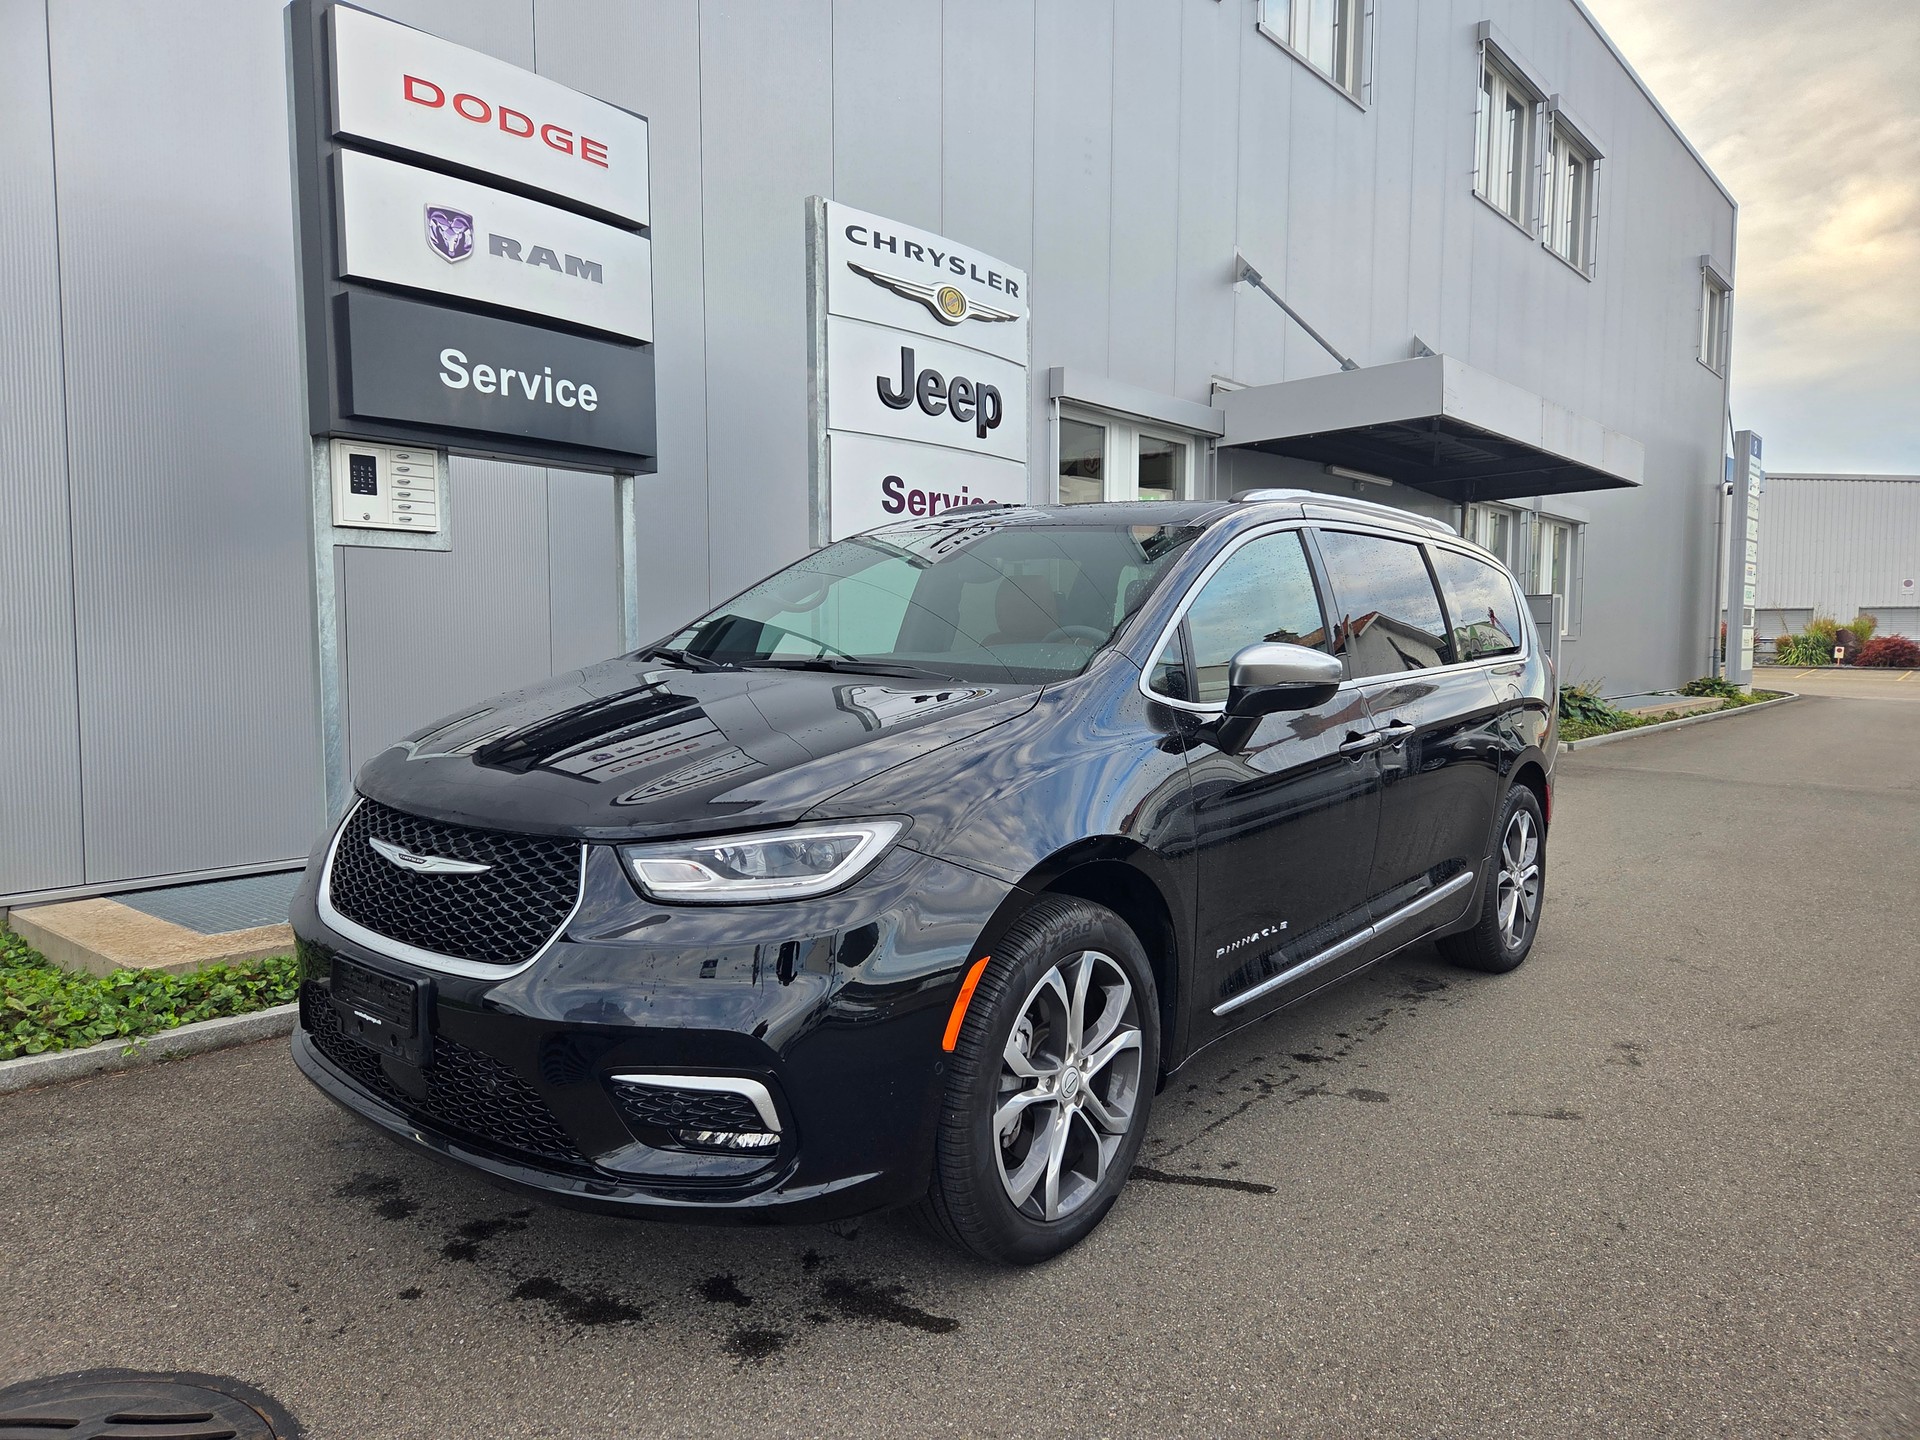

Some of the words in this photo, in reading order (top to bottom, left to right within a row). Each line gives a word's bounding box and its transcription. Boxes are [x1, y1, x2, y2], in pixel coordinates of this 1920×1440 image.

[403, 74, 609, 169] DODGE
[489, 233, 603, 284] RAM
[845, 225, 1019, 298] CHRYSLER
[439, 348, 599, 412] Service
[877, 346, 1003, 439] Jeep
[1216, 921, 1288, 959] PINNACLE
